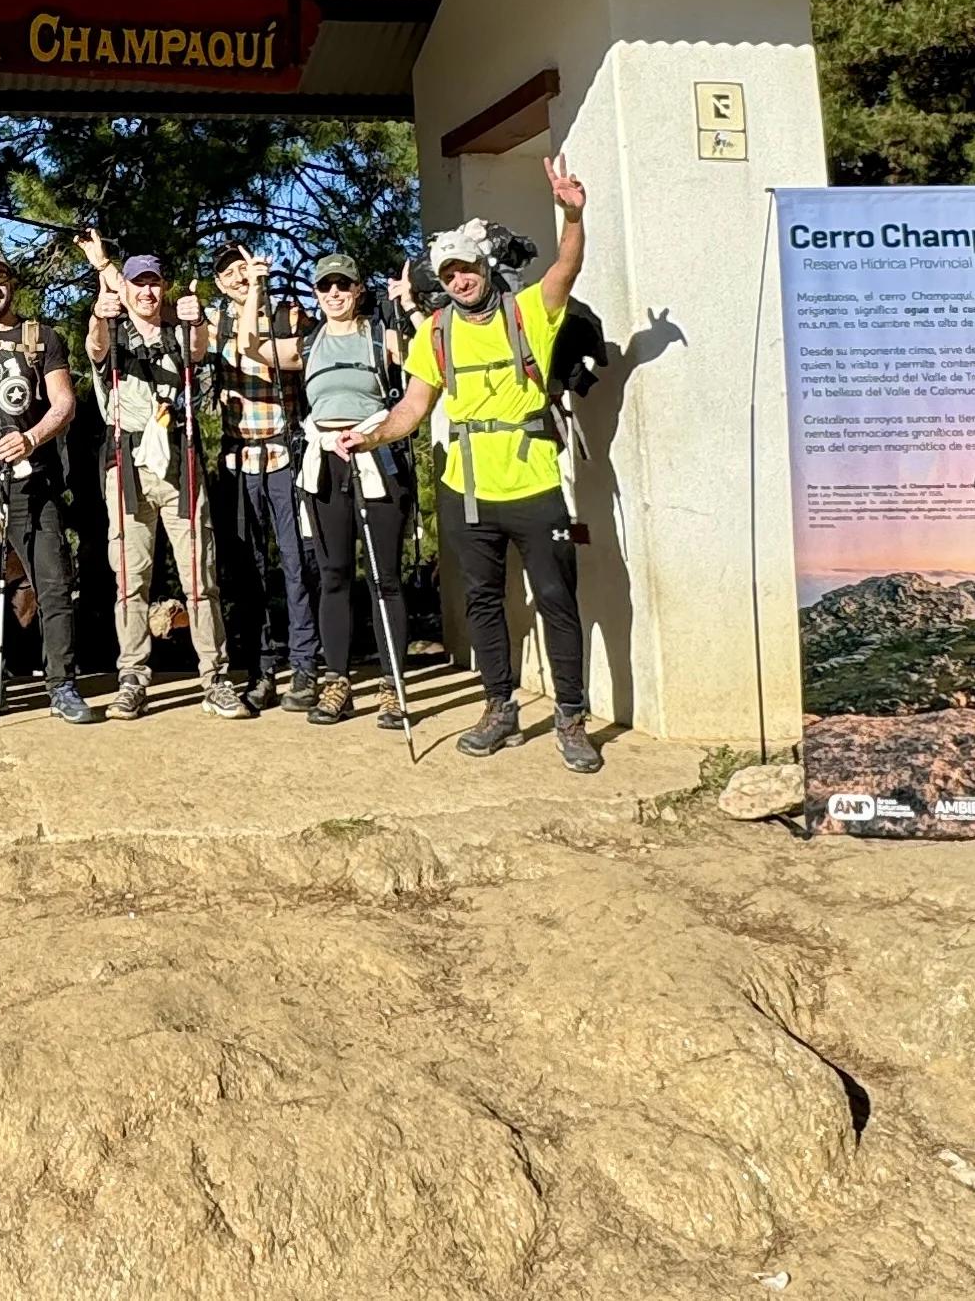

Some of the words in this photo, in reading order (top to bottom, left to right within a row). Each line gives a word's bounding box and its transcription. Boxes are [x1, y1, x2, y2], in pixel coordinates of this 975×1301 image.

[29, 13, 278, 69] CHAMPAQUÍ
[790, 224, 874, 249] Cerro
[880, 223, 975, 254] Cham
[803, 258, 858, 270] Reserva
[909, 256, 973, 270] Provincial
[864, 291, 874, 301] el
[879, 293, 906, 301] cerro
[854, 304, 898, 318] significa
[844, 320, 856, 329] es
[871, 318, 911, 329] cumbre
[960, 317, 974, 328] de
[800, 346, 834, 357] Desde
[835, 347, 848, 357] su
[849, 346, 906, 358] imponente
[939, 346, 963, 355] sirve
[800, 360, 832, 372] quien
[851, 359, 879, 370] visita
[884, 361, 891, 371] y
[895, 359, 936, 371] permite
[801, 373, 837, 384] mente
[903, 372, 919, 383] del
[920, 372, 948, 382] Valle
[950, 371, 964, 382] de
[802, 389, 809, 399] y
[825, 387, 863, 397] belleza
[865, 386, 882, 397] del
[883, 386, 911, 396] Valle
[914, 386, 928, 396] de
[803, 414, 861, 425] Cristalinos
[863, 415, 903, 427] arroyos
[906, 415, 942, 424] surcan
[945, 413, 955, 423] la
[804, 429, 842, 439] nentes
[843, 428, 910, 439] formaciones
[805, 444, 826, 455] gos
[828, 442, 845, 453] del
[848, 443, 882, 455] origen
[949, 441, 963, 451] de
